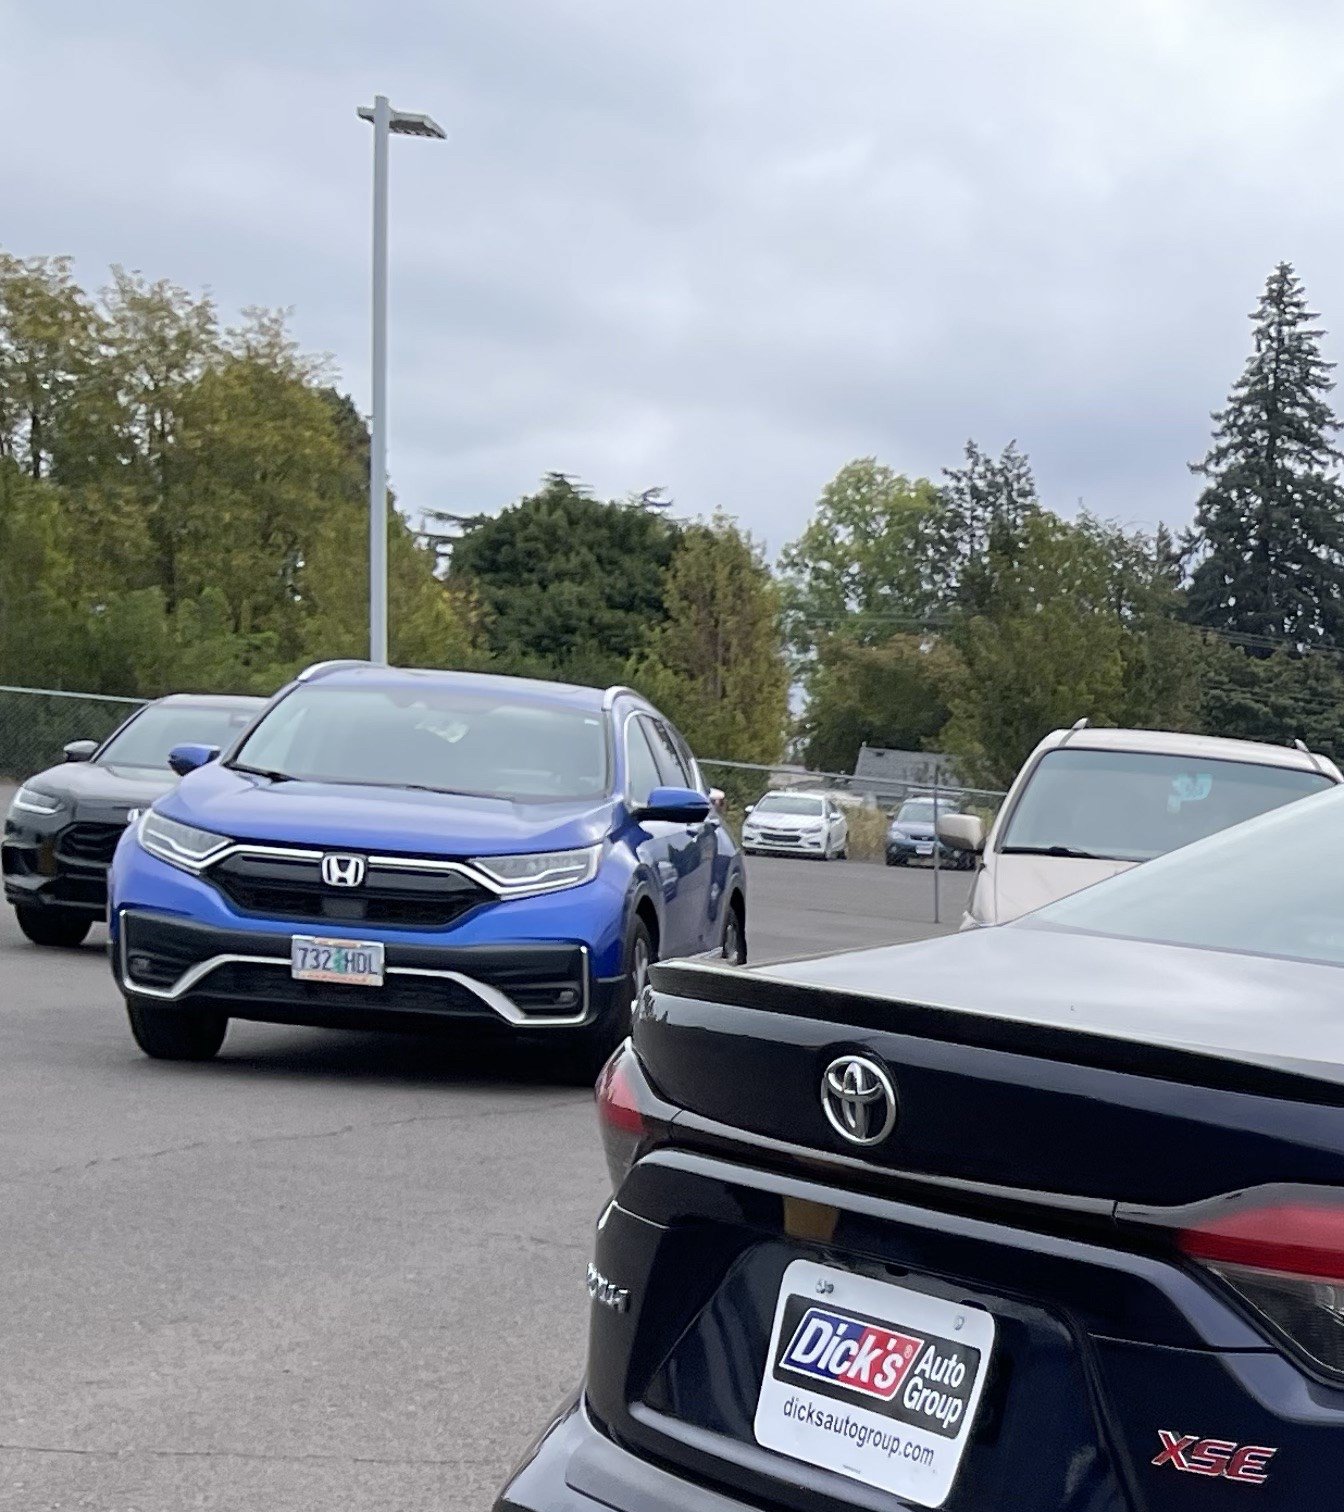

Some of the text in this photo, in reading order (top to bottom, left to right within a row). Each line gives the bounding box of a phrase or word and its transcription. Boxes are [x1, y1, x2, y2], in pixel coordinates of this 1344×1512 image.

[298, 947, 378, 975] 732 HDL
[914, 1345, 966, 1388] Auto
[903, 1378, 963, 1429] Group
[783, 1396, 935, 1467] dicksautogroup.com
[1151, 1429, 1278, 1484] XSE
